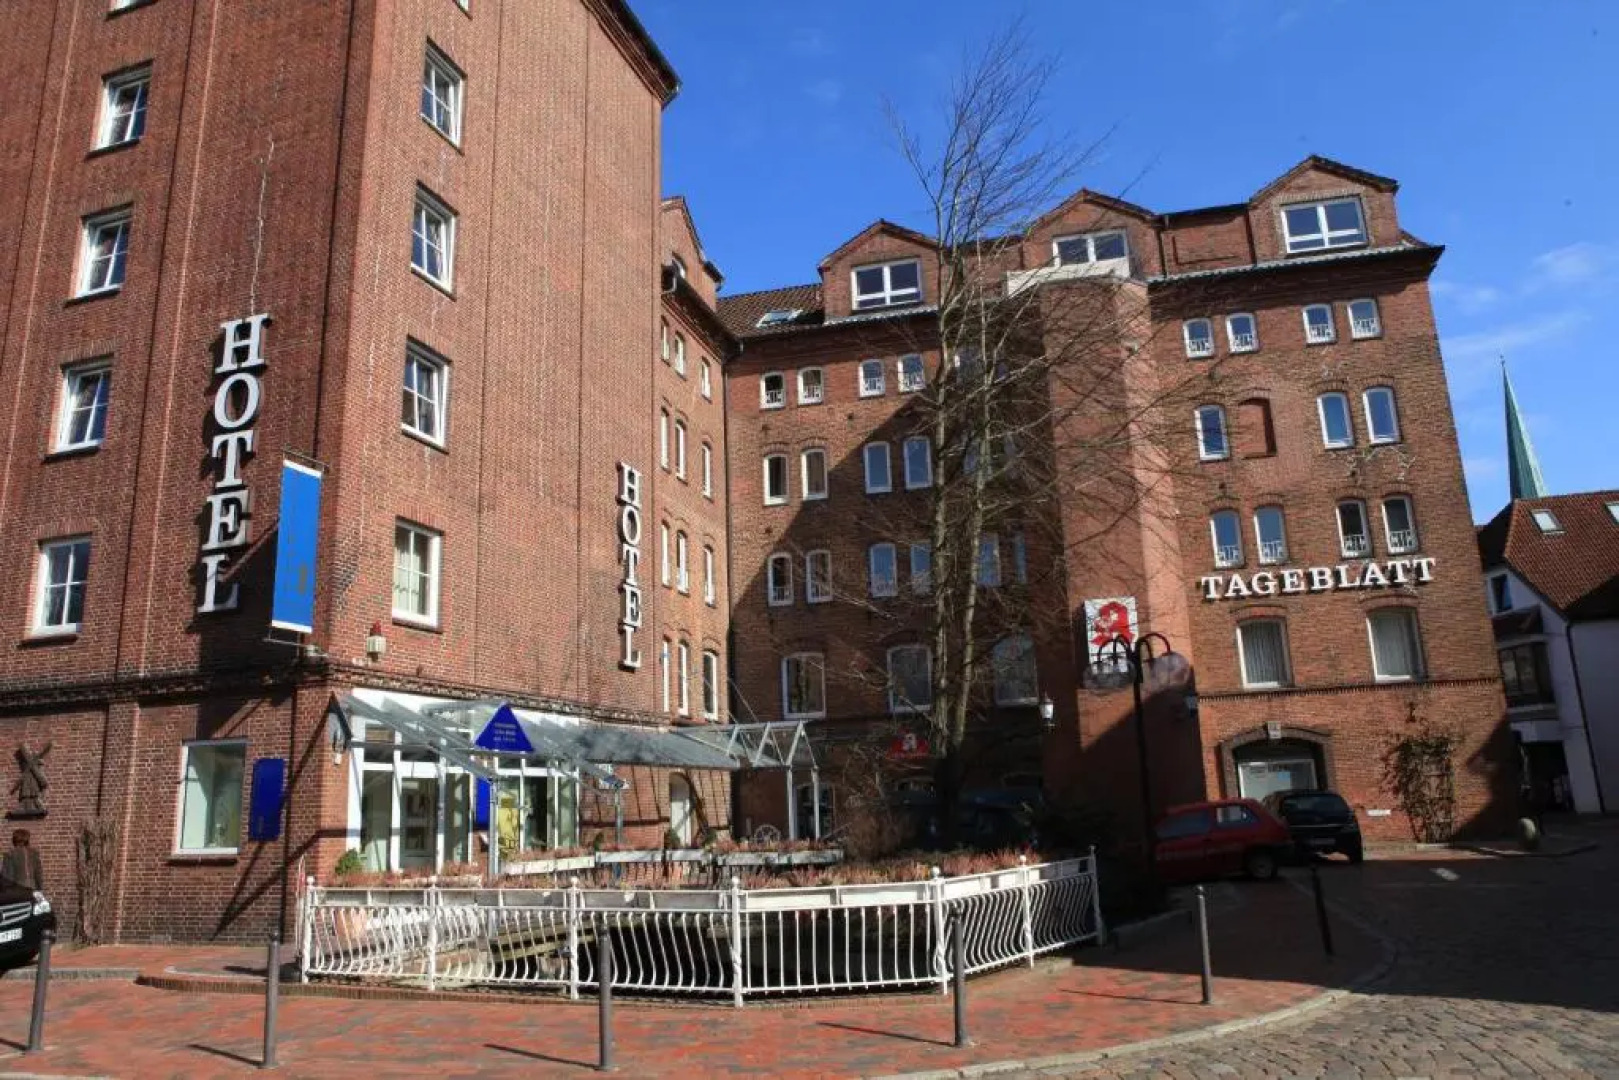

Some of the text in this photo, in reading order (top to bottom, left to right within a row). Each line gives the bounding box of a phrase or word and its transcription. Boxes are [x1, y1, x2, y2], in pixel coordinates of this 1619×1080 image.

[199, 313, 271, 613] HOTEL
[621, 462, 643, 668] HOTEL
[1201, 557, 1436, 599] TAGEBLATT
